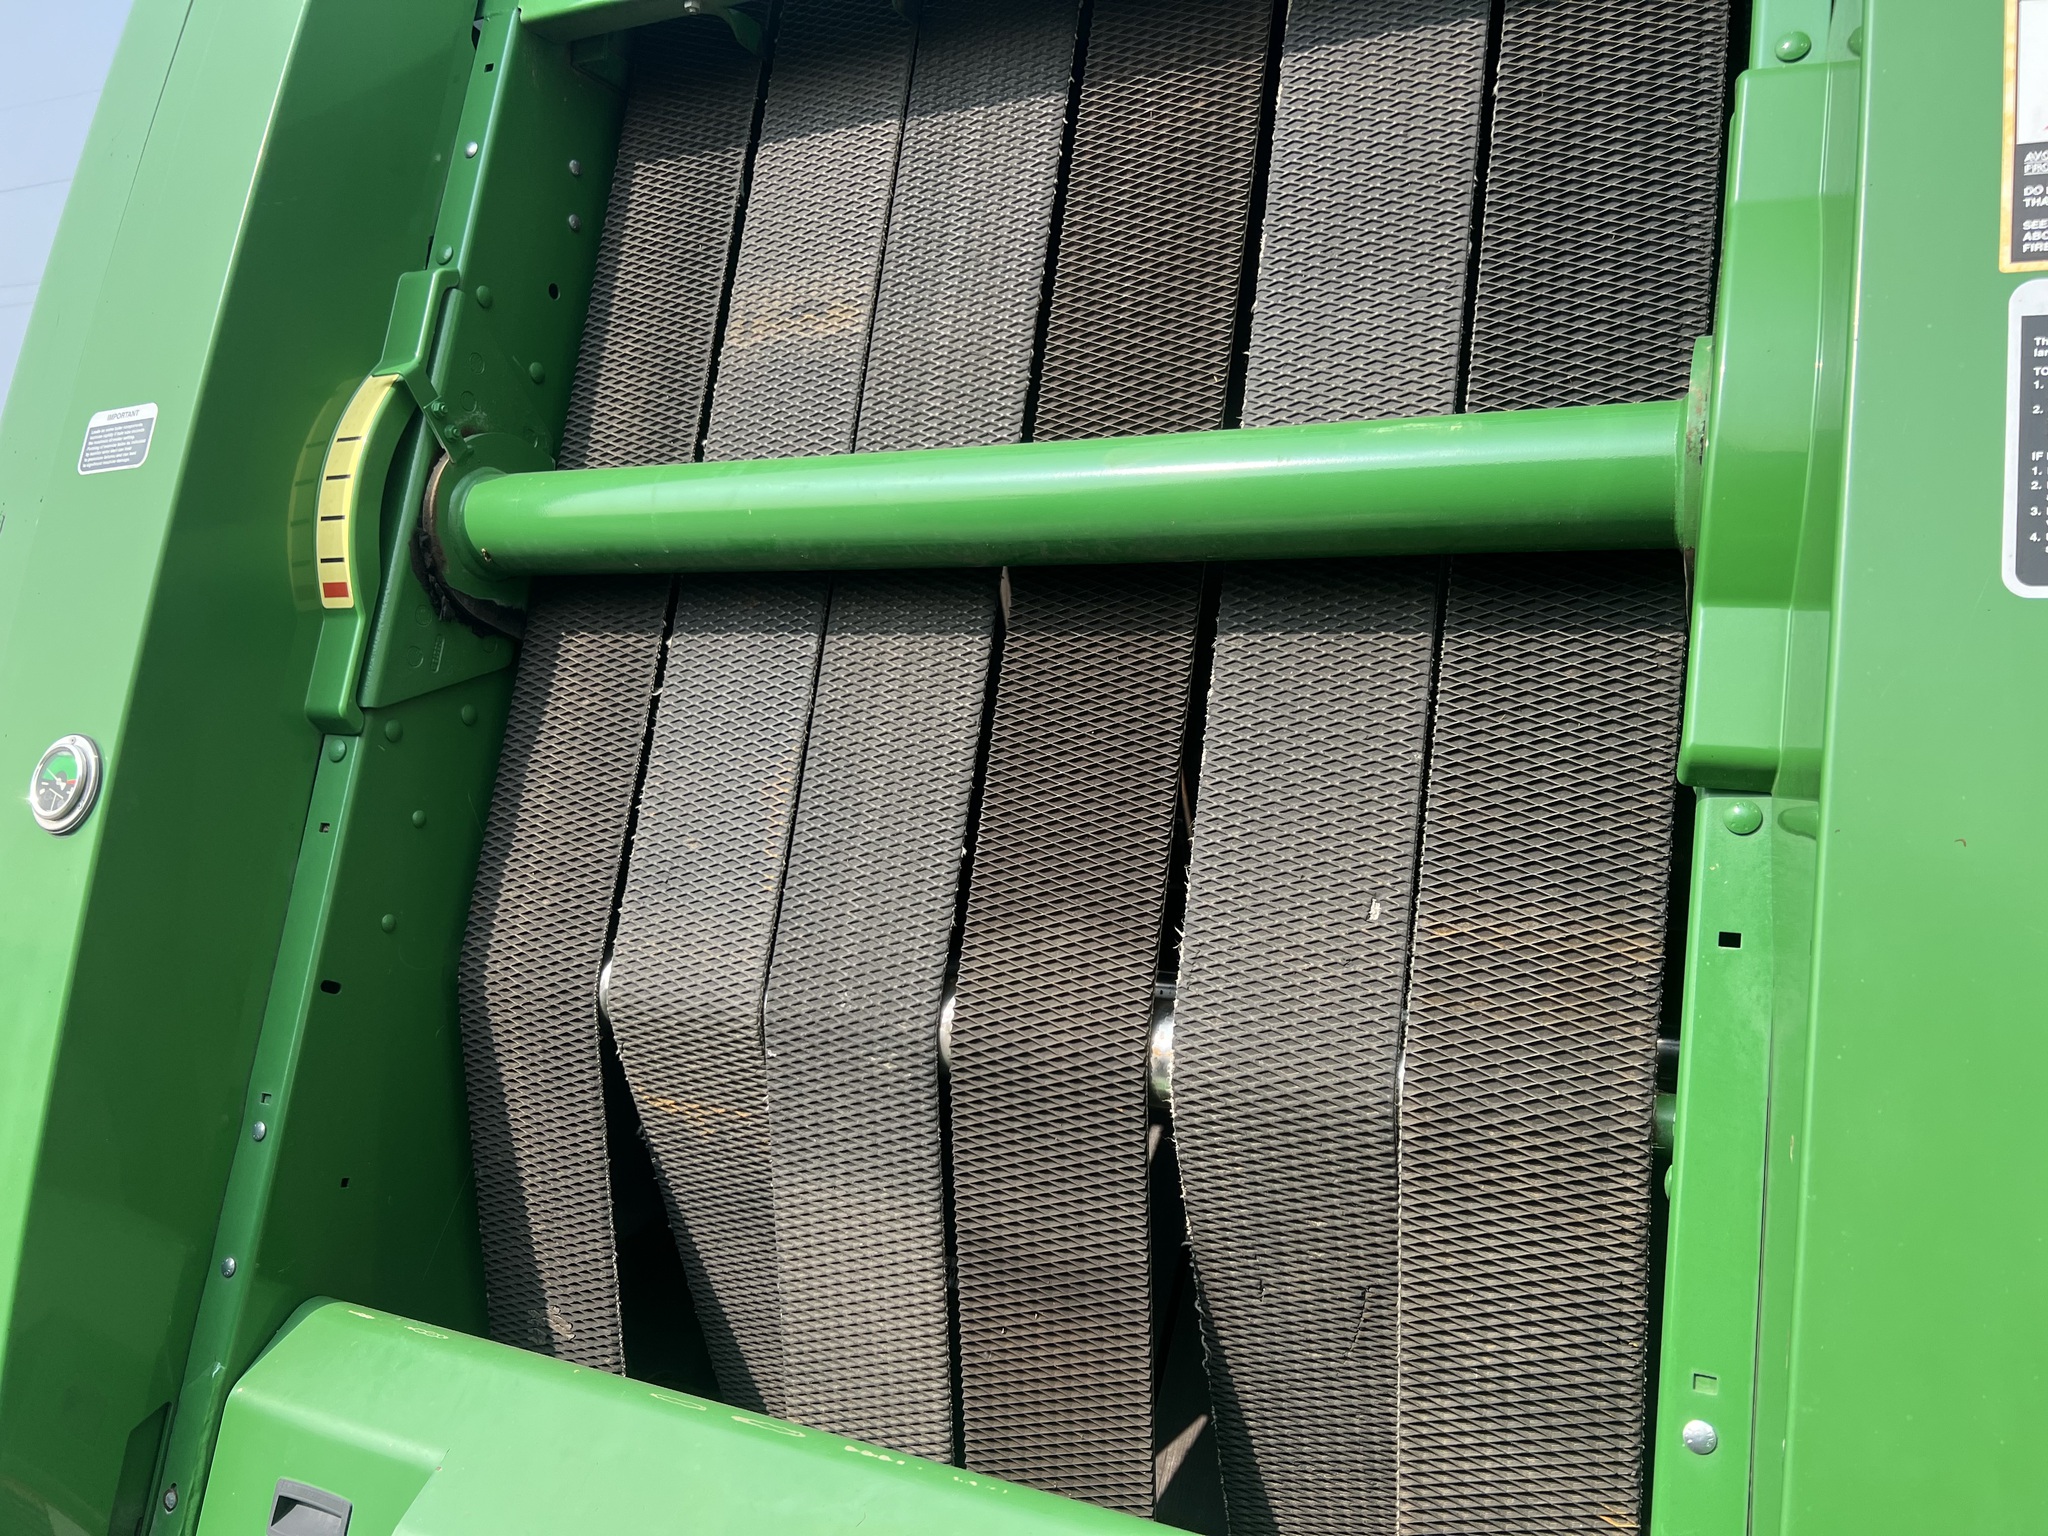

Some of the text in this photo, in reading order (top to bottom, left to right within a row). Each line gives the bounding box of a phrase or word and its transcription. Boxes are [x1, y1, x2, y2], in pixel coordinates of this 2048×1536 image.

[2023, 184, 2044, 196] DO
[2033, 380, 2044, 390] 1.
[2032, 405, 2043, 414] 2.
[107, 409, 140, 421] IMPORTANT
[2032, 451, 2043, 461] IF
[2031, 466, 2042, 476] 1.
[2030, 480, 2042, 490] 2.
[2030, 506, 2041, 516] 3.
[2029, 532, 2041, 542] 4.
